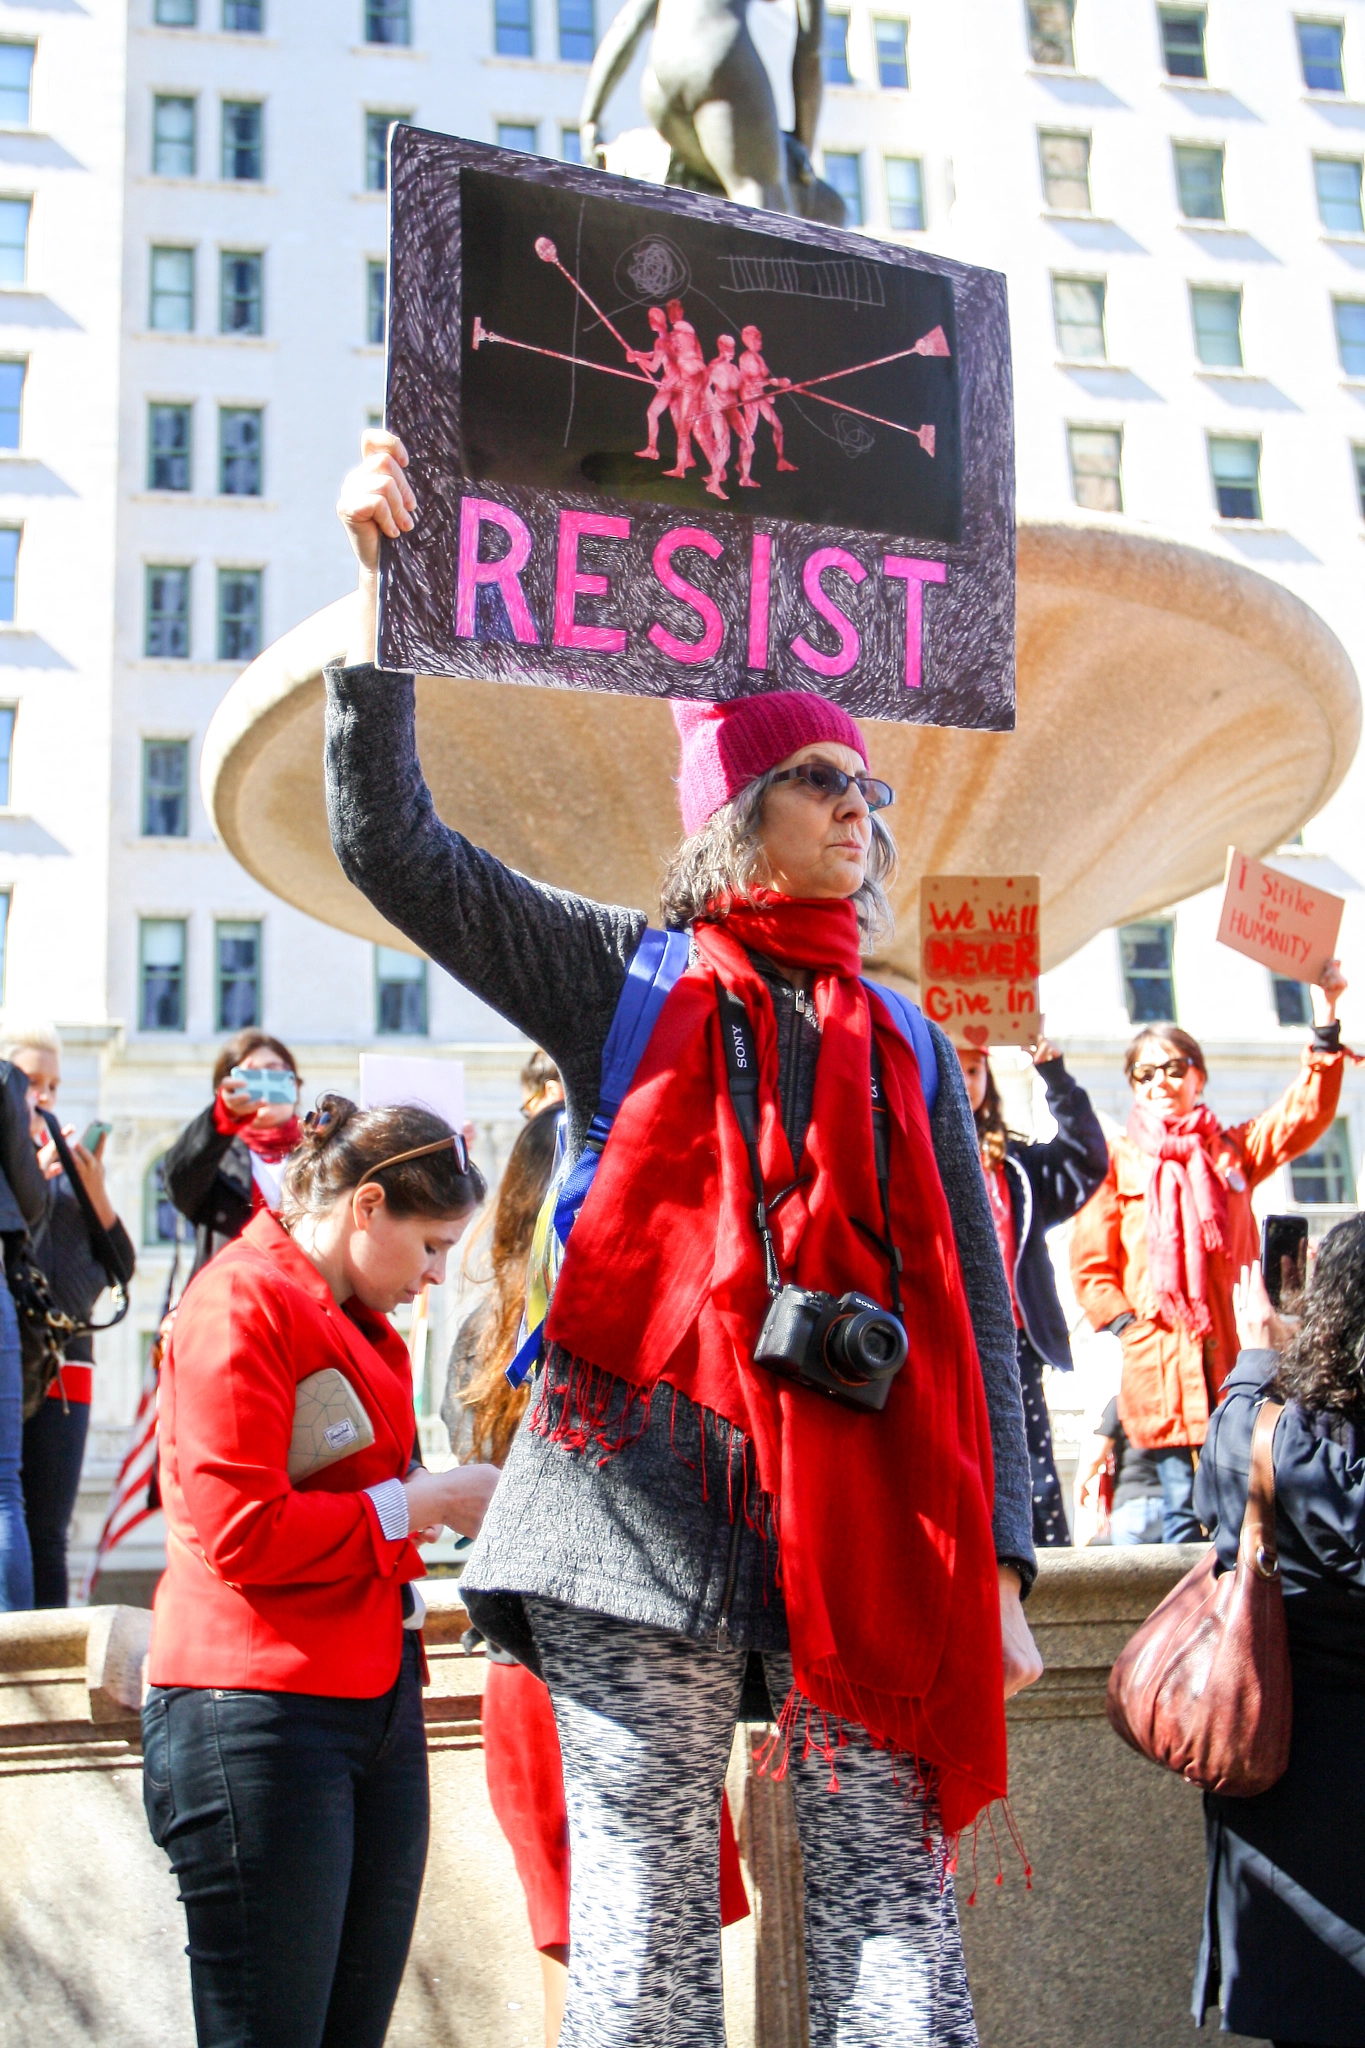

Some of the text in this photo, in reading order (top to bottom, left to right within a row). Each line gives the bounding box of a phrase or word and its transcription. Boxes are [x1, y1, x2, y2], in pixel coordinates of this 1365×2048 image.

[455, 496, 947, 688] RESIST
[1238, 857, 1315, 917] I Strike
[929, 901, 976, 932] We
[1259, 902, 1281, 924] for
[1229, 907, 1313, 964] HUMANITY
[930, 936, 1041, 980] NEVER
[925, 985, 992, 1023] Give
[731, 1024, 748, 1068] SONY
